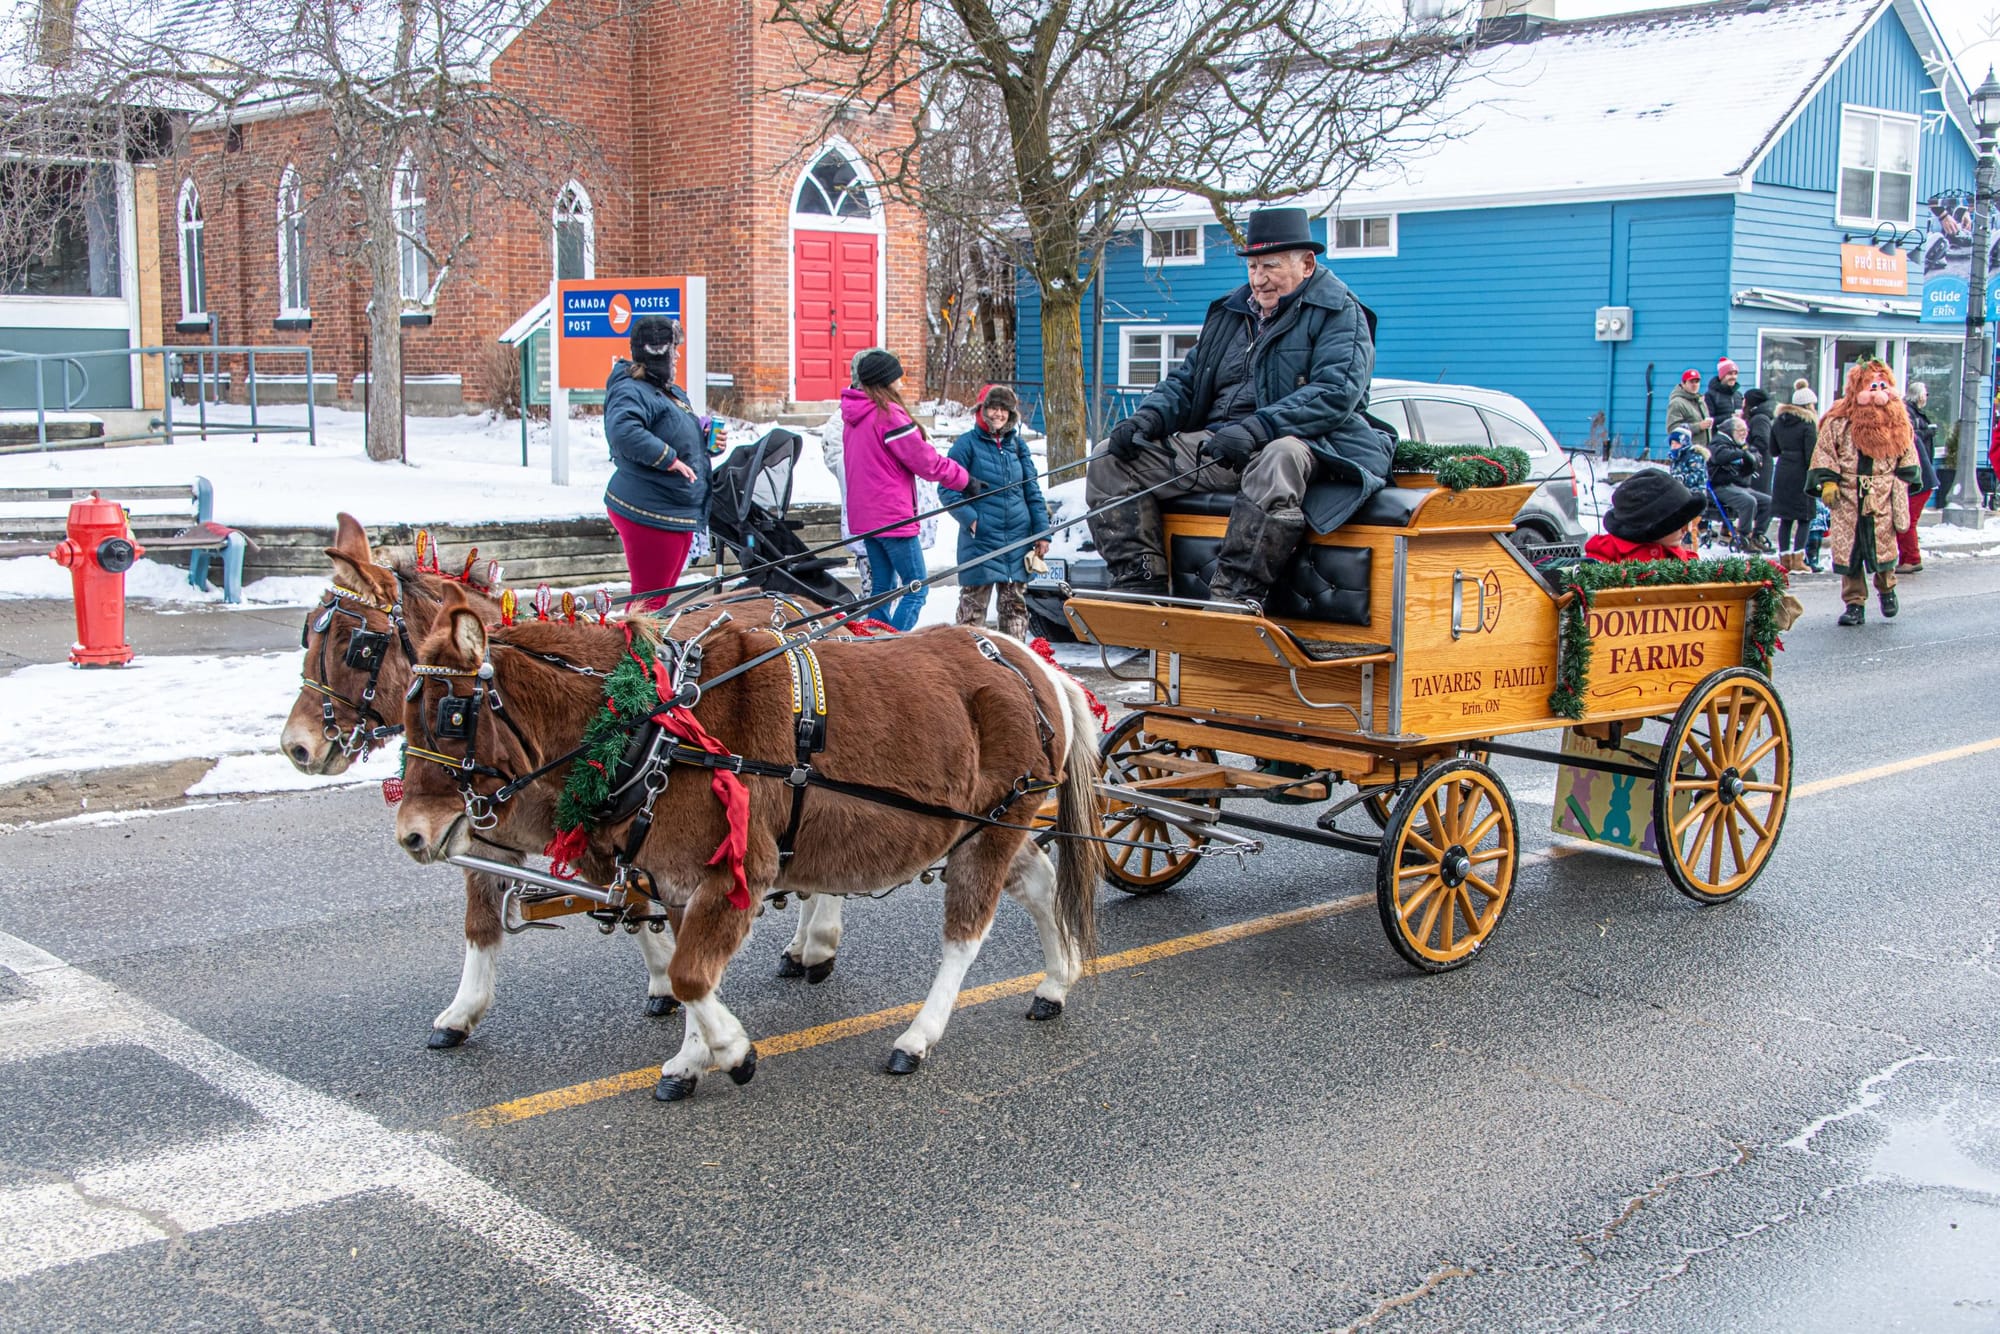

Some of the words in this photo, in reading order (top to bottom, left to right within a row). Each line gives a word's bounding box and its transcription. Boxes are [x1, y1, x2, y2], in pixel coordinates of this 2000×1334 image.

[1876, 257, 1897, 272] ERIN
[568, 298, 606, 309] CANADA
[634, 296, 670, 308] POSTES
[1930, 291, 1960, 302] Glide
[1932, 305, 1956, 317] ERIN
[568, 320, 591, 331] POST
[1485, 583, 1498, 597] D
[1486, 606, 1497, 620] F
[1587, 605, 1731, 639] DOMINION
[1609, 641, 1705, 674] FARMS
[1412, 671, 1482, 697] TAVARES
[1494, 666, 1548, 689] FAMILY
[1462, 702, 1483, 716] Erin,
[1485, 699, 1500, 713] ON
